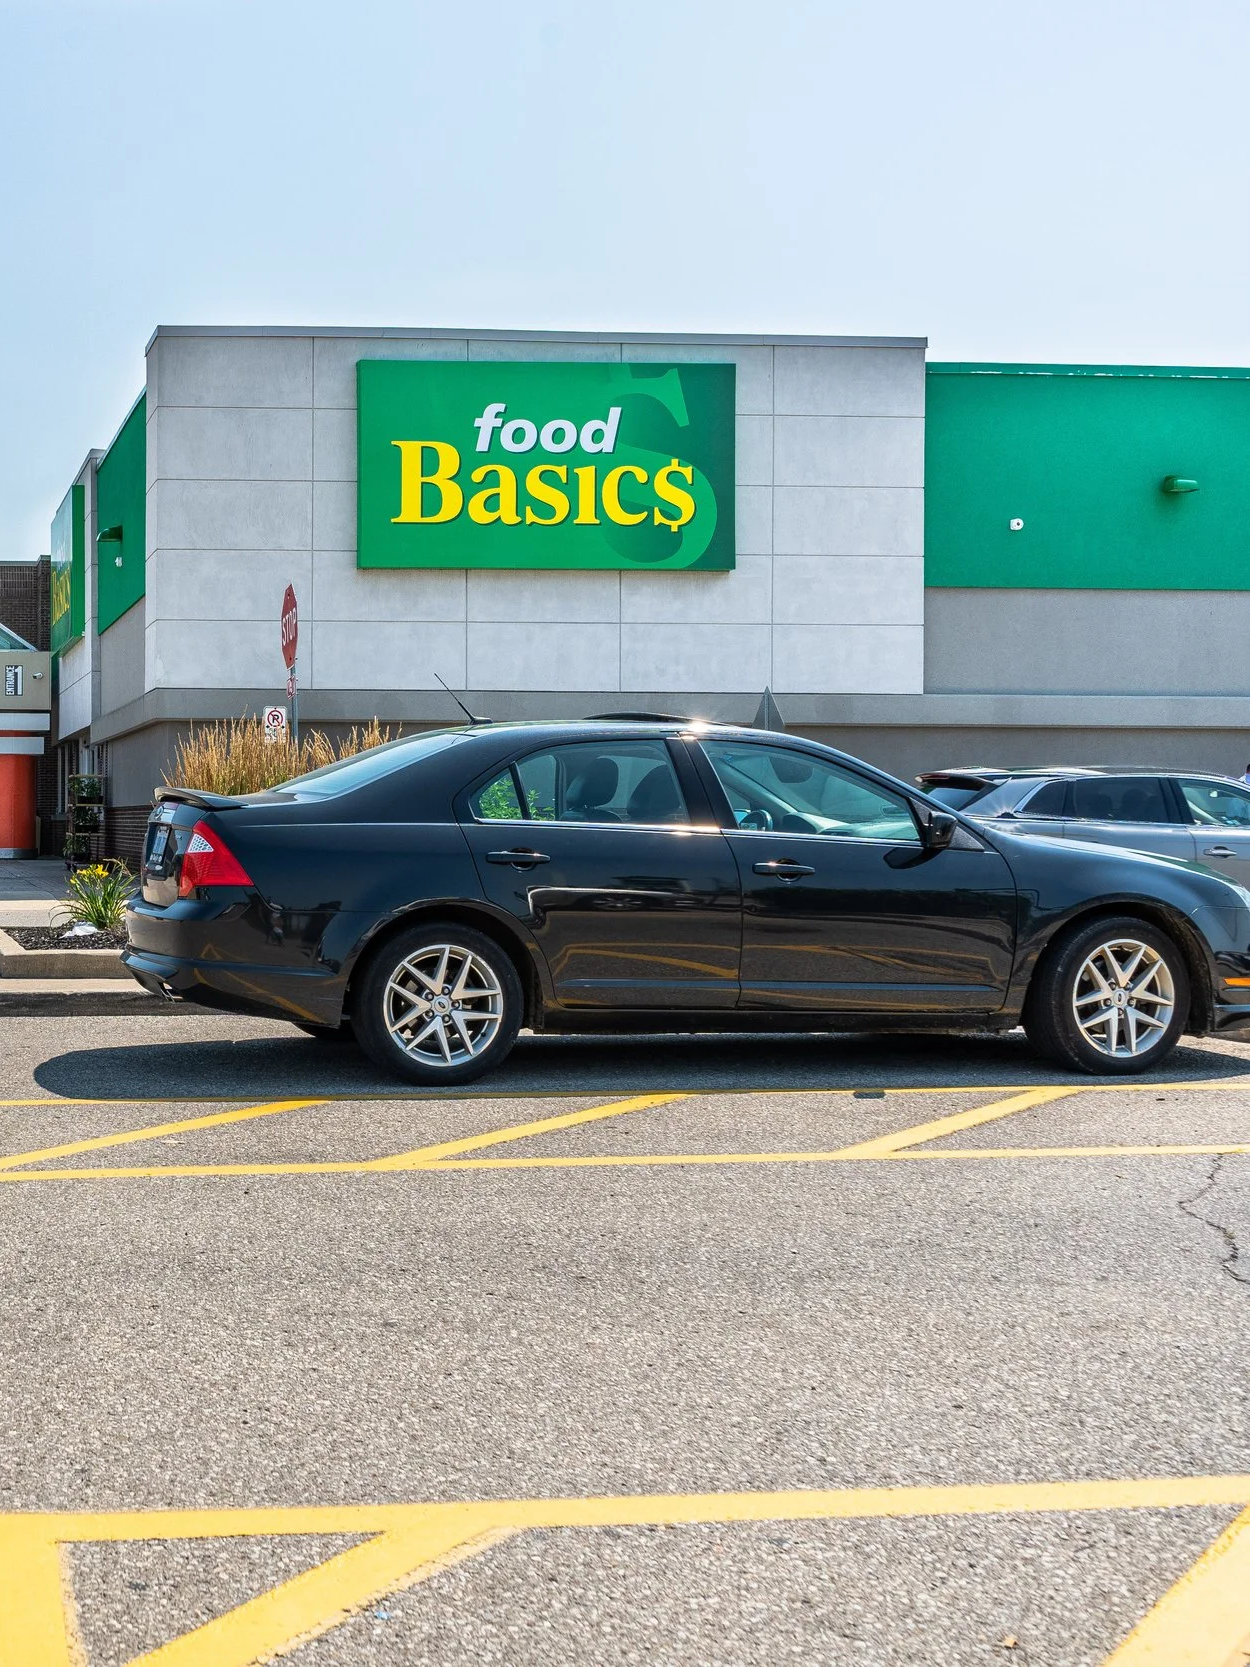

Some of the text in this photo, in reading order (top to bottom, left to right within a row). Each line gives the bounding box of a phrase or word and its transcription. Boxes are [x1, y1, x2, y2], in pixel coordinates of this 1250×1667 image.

[473, 403, 623, 454] food
[282, 607, 297, 647] STOP
[6, 665, 15, 695] ENTRANCE
[15, 665, 23, 695] 1
